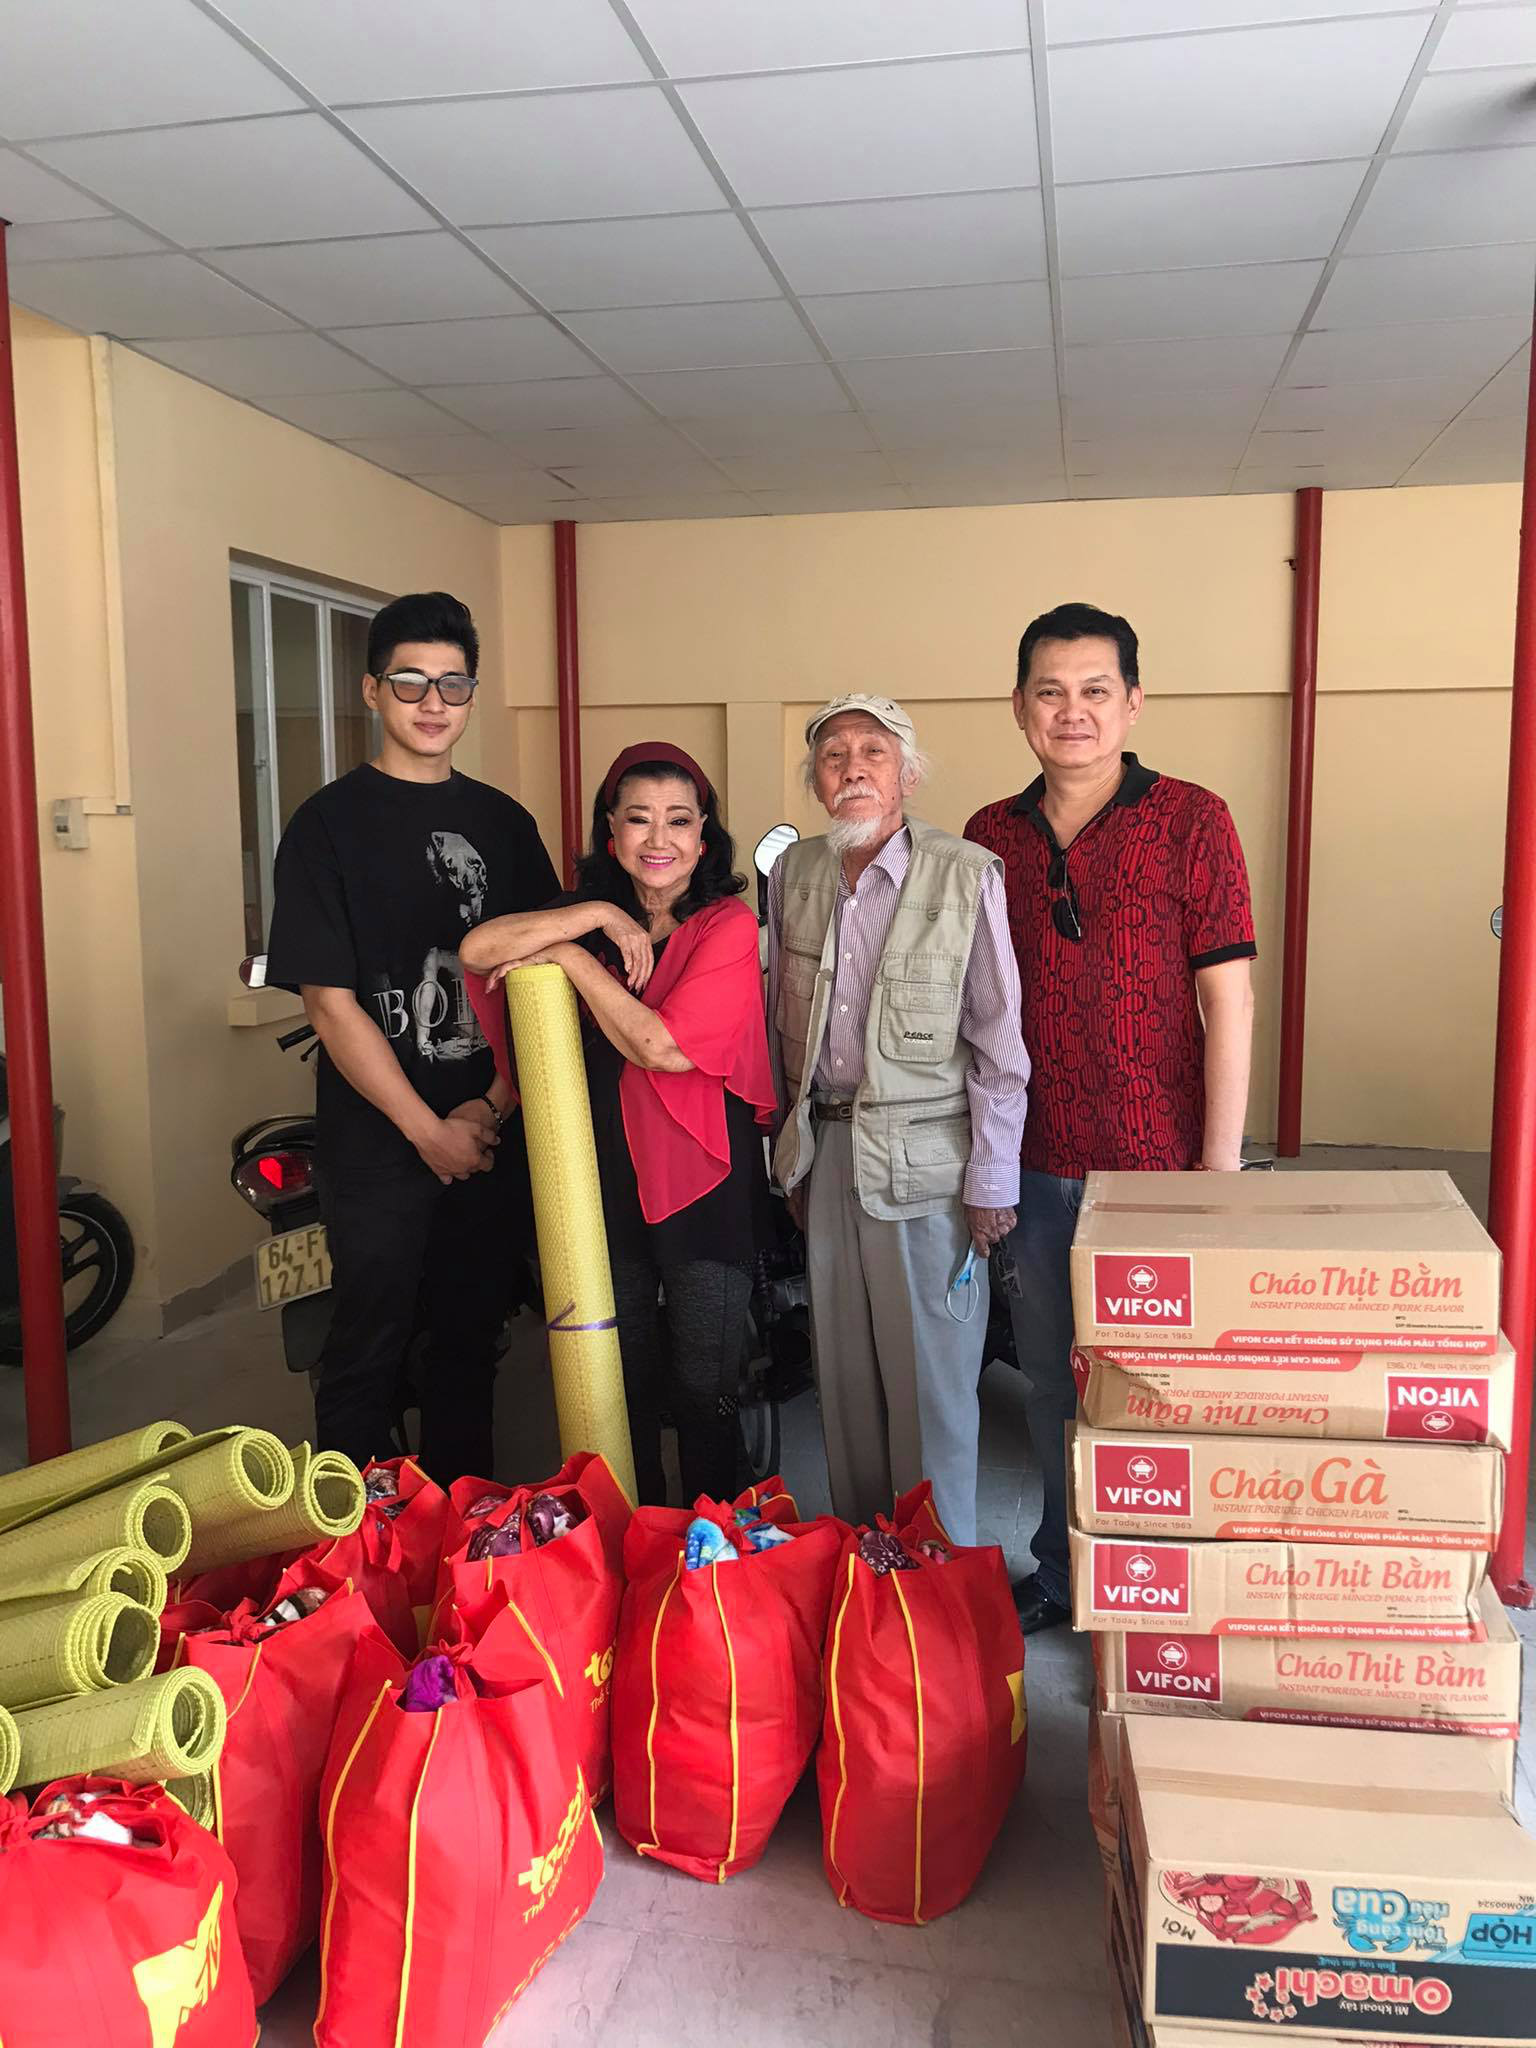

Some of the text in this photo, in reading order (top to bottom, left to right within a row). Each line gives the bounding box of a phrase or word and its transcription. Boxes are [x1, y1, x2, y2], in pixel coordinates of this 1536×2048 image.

[1249, 1263, 1463, 1301] Cháo Thịt Bằm
[1105, 1297, 1183, 1317] VIFON
[1250, 1300, 1464, 1313] INSTANT PORRIDGE MINCED PORK FLAVOR
[1113, 1330, 1140, 1340] Today
[1232, 1335, 1260, 1344] VIFON
[1262, 1336, 1283, 1344] CAM
[1290, 1356, 1311, 1364] CAM
[1312, 1357, 1341, 1365] VIFON
[1162, 1389, 1190, 1397] PORK
[1192, 1390, 1232, 1399] MINCED
[1233, 1391, 1285, 1400] PORRIDGE
[1286, 1393, 1329, 1402] INSTANT
[1398, 1386, 1480, 1407] VIFON
[1202, 1400, 1259, 1425] Thịt
[1263, 1406, 1329, 1424] Cháo
[1209, 1457, 1389, 1505] Cháo Gà
[1105, 1486, 1181, 1507] VIFON
[1213, 1503, 1390, 1519] INSTANT PORRIDGE CHICKEN FLAVOR
[1114, 1519, 1141, 1528] Today
[1232, 1526, 1260, 1534] VIFON
[1262, 1526, 1283, 1535] CAM
[1246, 1556, 1453, 1592] Cháo Thịt Bằm
[1103, 1585, 1180, 1606] VIFON
[1111, 1616, 1138, 1625] Today
[1227, 1623, 1256, 1632] VIFON
[1257, 1624, 1277, 1632] CAM
[1277, 1650, 1487, 1688] Cháo Thịt Bằm
[1135, 1670, 1211, 1692] VIFON
[1333, 1887, 1410, 1921] Cua
[1471, 1918, 1533, 1949] HỘP
[1275, 1967, 1453, 2016] Omachi
[1360, 2002, 1393, 2014] khoai
